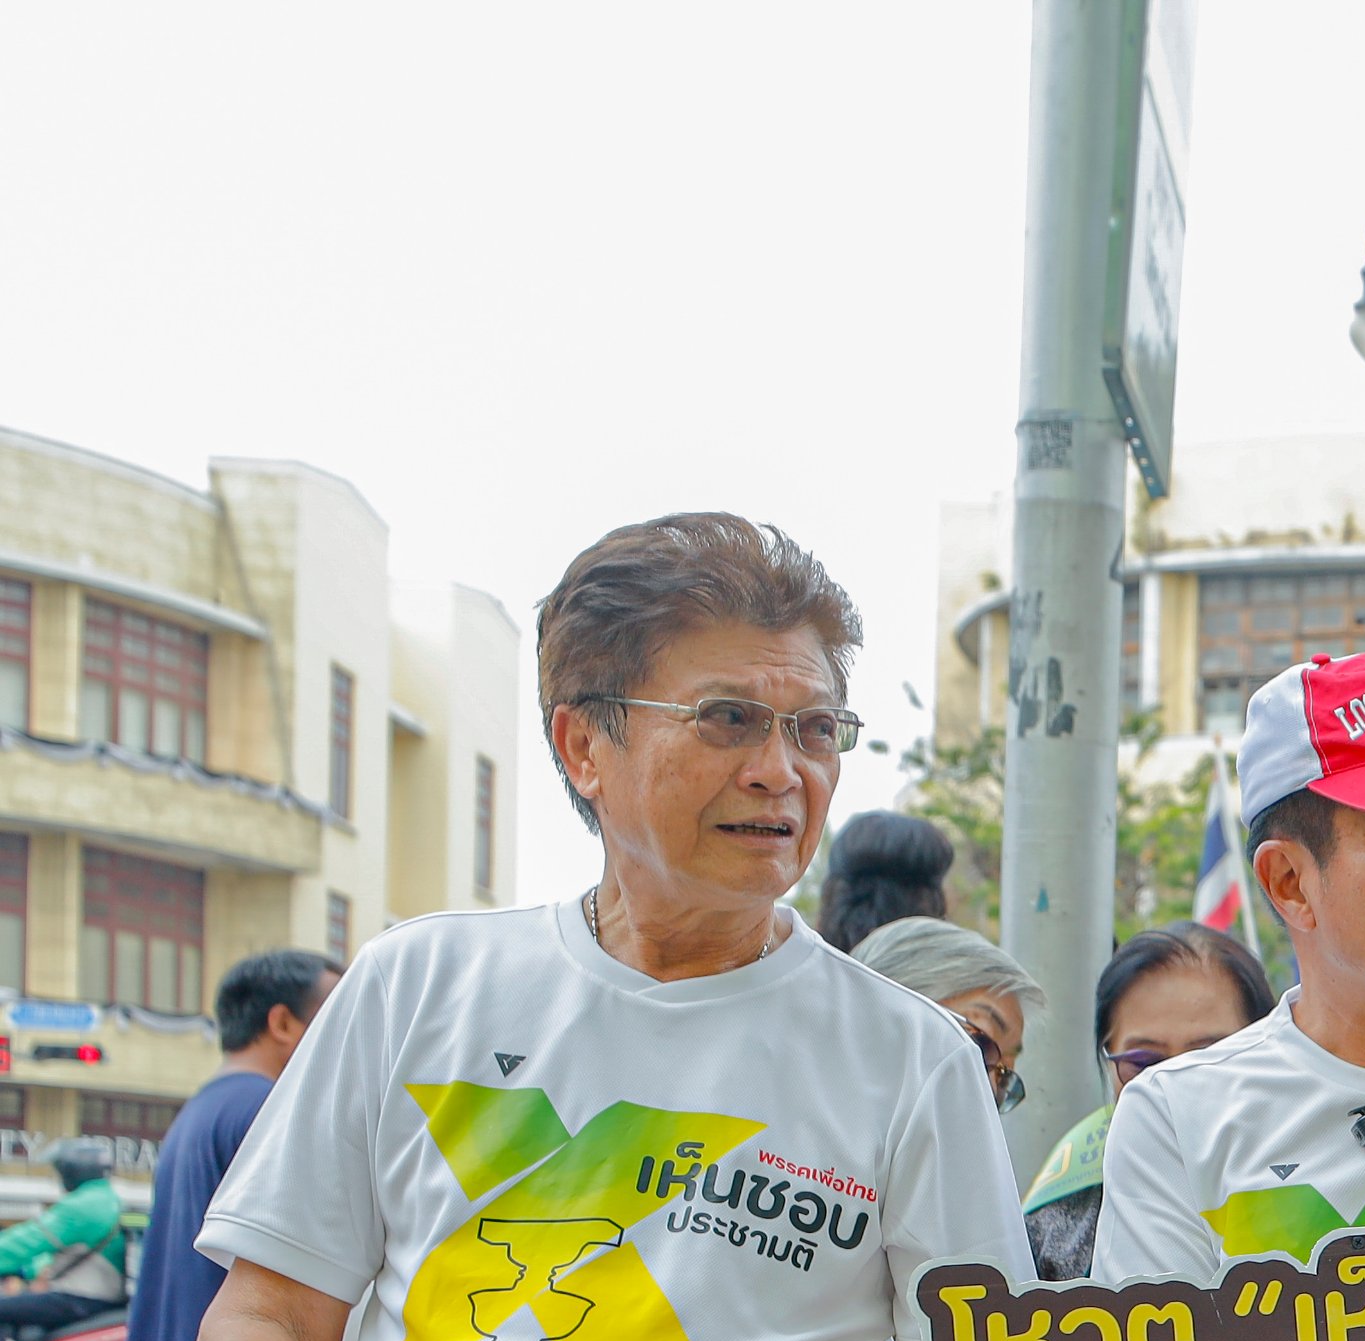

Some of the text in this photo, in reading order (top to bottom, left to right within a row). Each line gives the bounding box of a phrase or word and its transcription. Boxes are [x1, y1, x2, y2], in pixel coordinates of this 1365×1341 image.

[636, 1141, 869, 1250] เห็นชอบ
[758, 1149, 877, 1202] พรรคเพื่อไทย
[667, 1204, 818, 1272] ประชามติ
